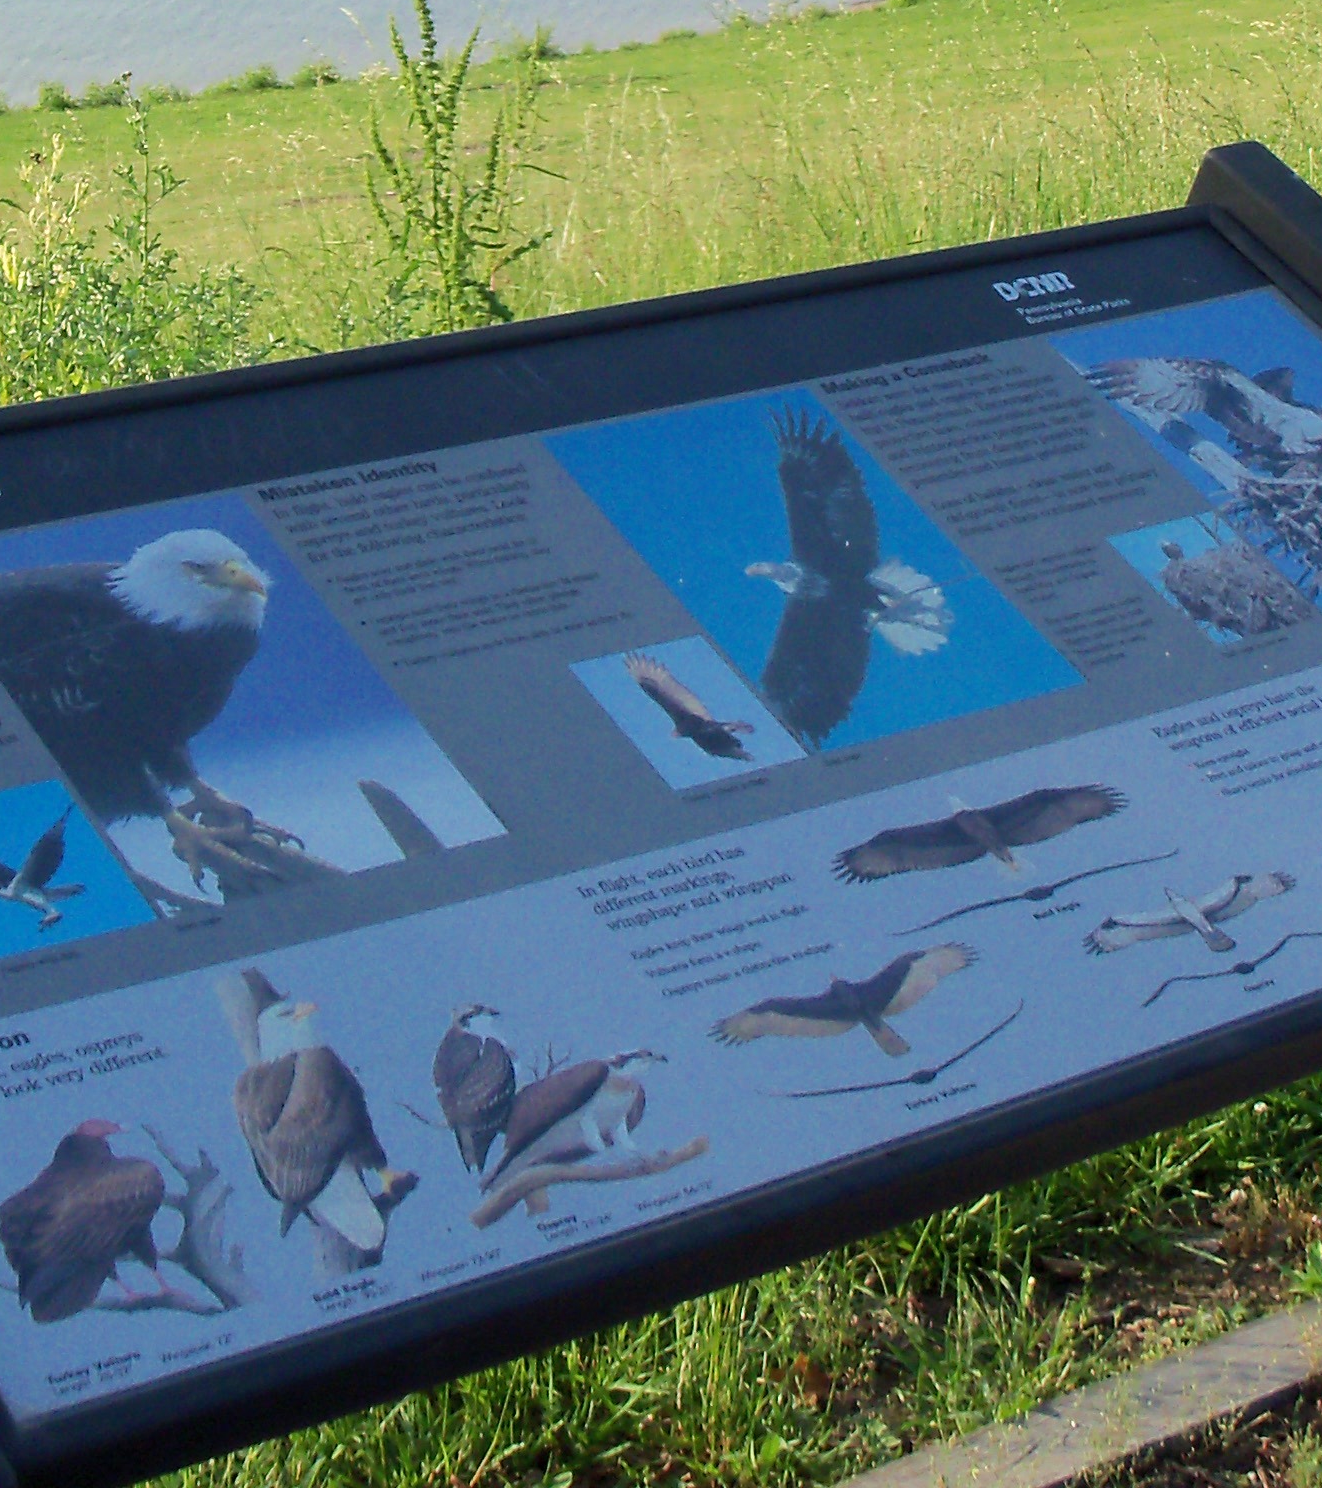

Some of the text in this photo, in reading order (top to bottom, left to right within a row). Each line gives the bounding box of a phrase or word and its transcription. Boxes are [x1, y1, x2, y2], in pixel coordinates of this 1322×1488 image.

[992, 271, 1076, 302] DCNR
[819, 375, 890, 395] Making
[257, 462, 438, 502] Mistaken Identity
[576, 886, 598, 898] In
[646, 862, 683, 880] each
[681, 852, 716, 869] bird
[713, 847, 745, 860] has
[593, 890, 658, 915] different
[690, 891, 721, 908] and
[75, 1033, 143, 1056] ospreys
[45, 1068, 84, 1086] very
